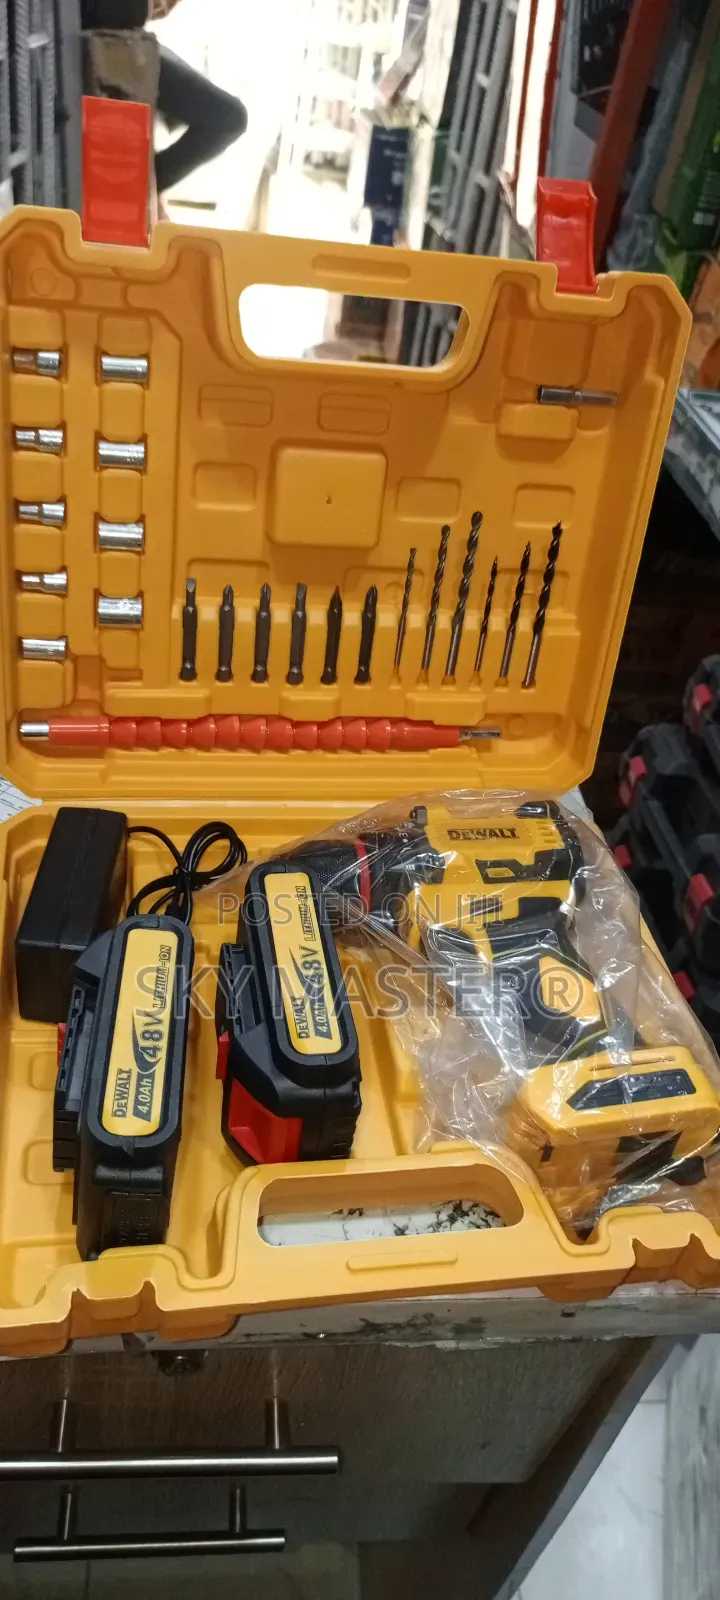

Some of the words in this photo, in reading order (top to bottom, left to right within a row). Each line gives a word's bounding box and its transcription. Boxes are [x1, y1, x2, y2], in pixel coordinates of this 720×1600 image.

[447, 828, 520, 840] DEWALT
[295, 885, 316, 942] LITHIUM-ION
[152, 945, 172, 1009] LITHIUM-ION
[299, 945, 325, 988] 48V
[143, 1010, 164, 1059] 48V
[313, 1002, 328, 1034] 4.0Ah
[112, 1068, 132, 1118] DEWALT
[139, 1078, 154, 1115] 4.0Ah
